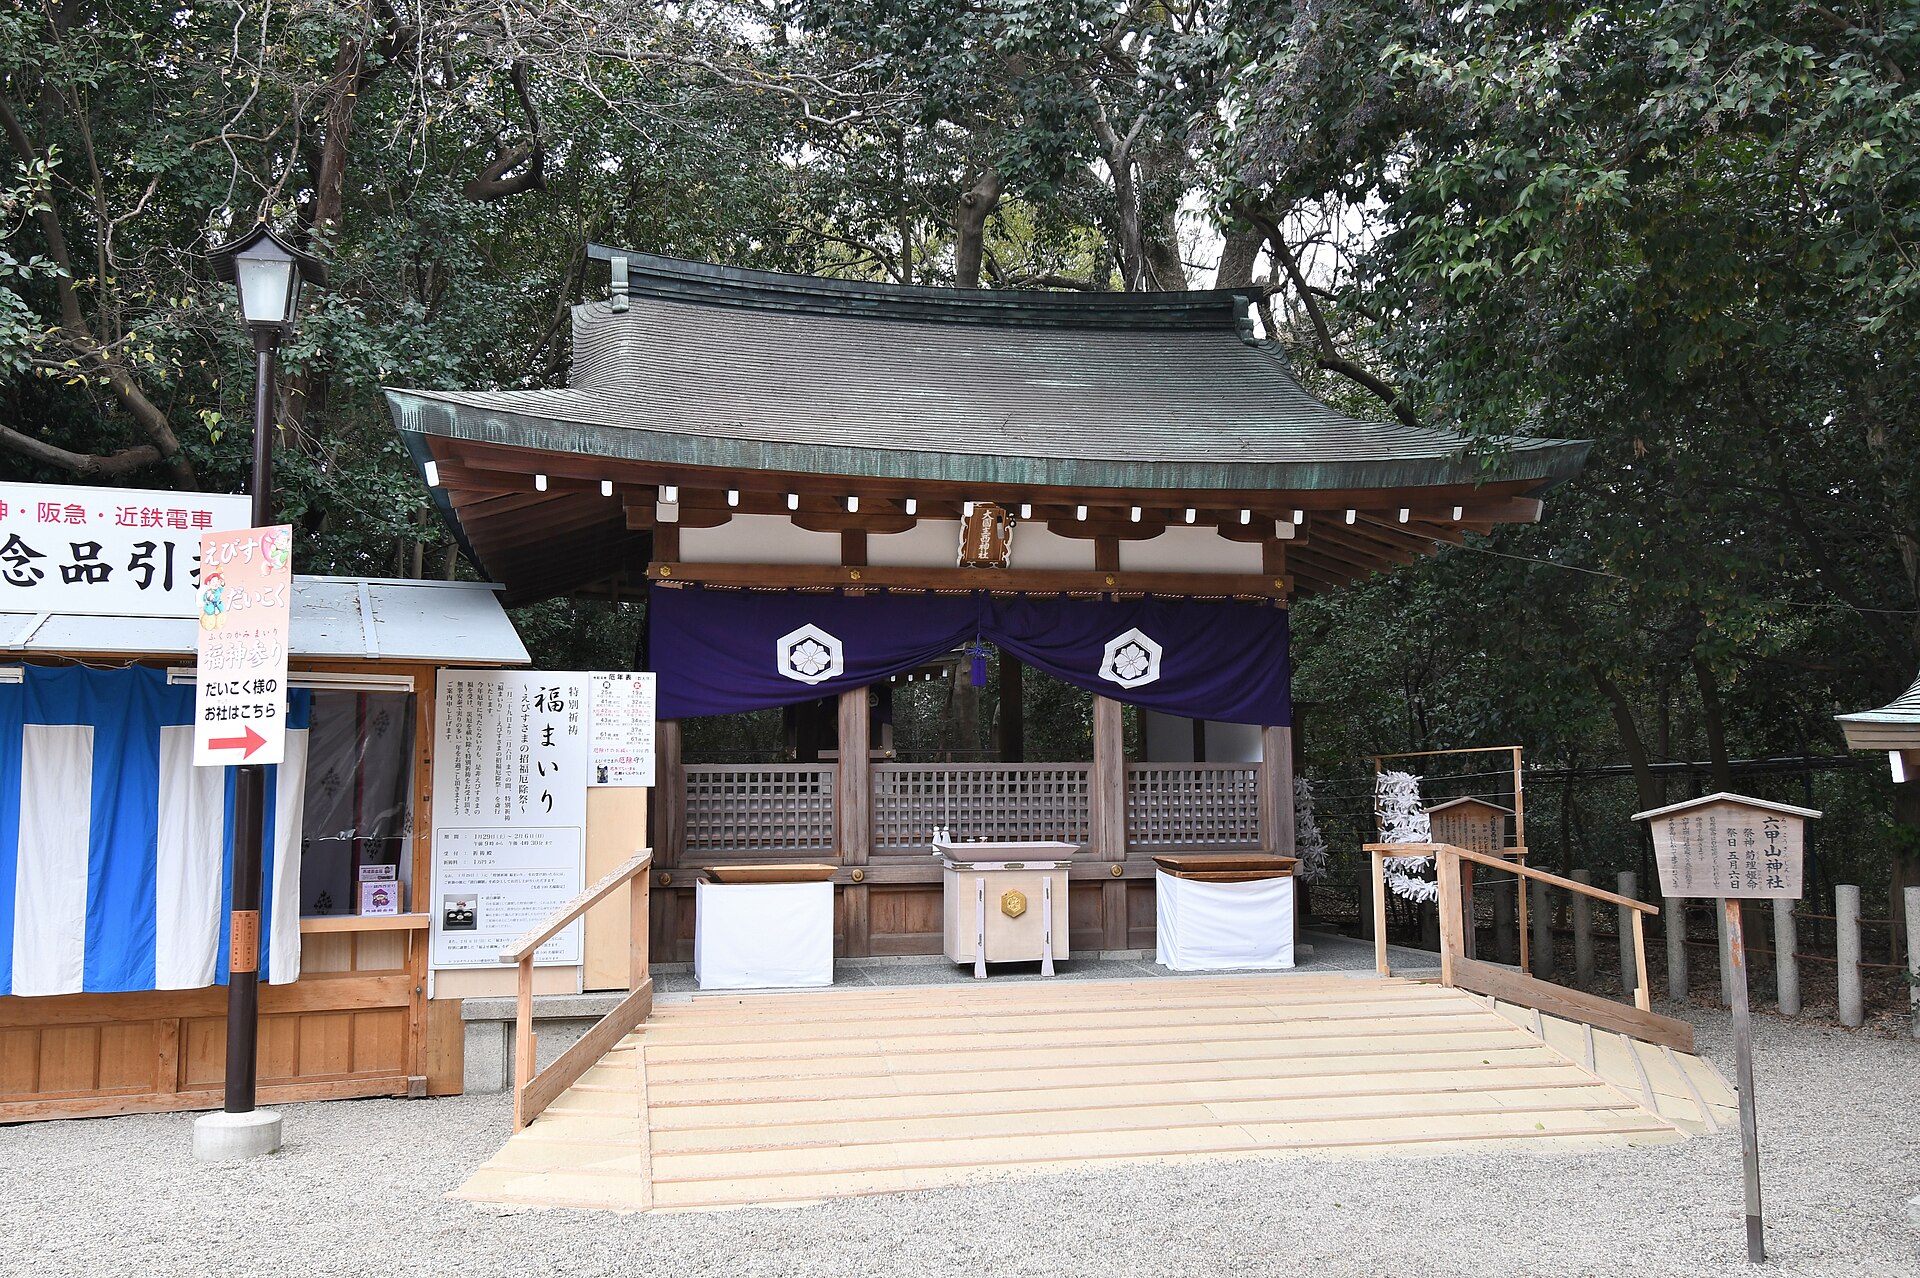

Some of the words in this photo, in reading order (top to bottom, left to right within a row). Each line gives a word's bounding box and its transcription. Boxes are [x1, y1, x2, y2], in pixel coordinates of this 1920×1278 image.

[0, 533, 202, 592] 念品引
[204, 538, 259, 566] えびす
[225, 582, 285, 612] だいこく
[204, 638, 284, 670] 福神参り
[205, 679, 277, 698] だいこく様の
[204, 702, 276, 721] お社はこちら
[534, 686, 565, 814] 福まいり
[1727, 828, 1738, 847] 祭日
[1743, 828, 1755, 848] 祭神
[1763, 816, 1785, 889] 六甲山神社
[1727, 851, 1740, 890] 五月六日
